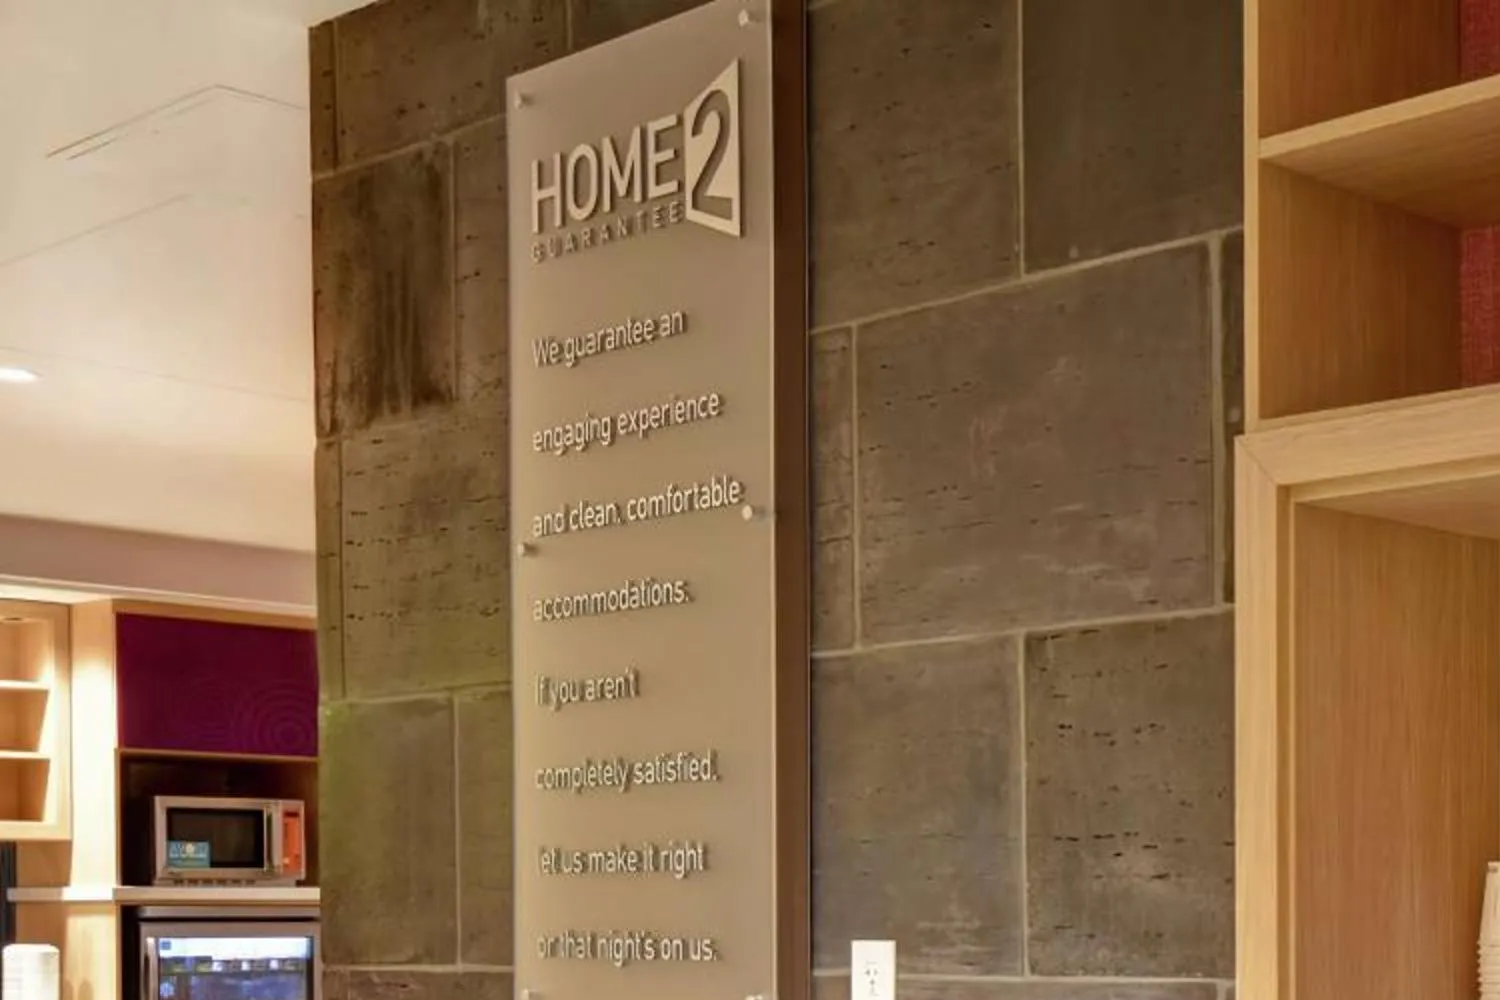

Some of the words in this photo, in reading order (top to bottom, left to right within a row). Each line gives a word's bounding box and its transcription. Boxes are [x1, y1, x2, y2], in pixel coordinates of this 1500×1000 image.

[532, 201, 684, 263] GUARANTEE
[532, 337, 559, 367] We
[564, 316, 655, 367] guarantee
[659, 311, 684, 337] an
[532, 412, 611, 456] engaging
[617, 392, 720, 439] experience
[532, 507, 565, 538] and
[627, 475, 741, 521] comfortable
[533, 578, 690, 622] accommodations.
[549, 681, 580, 711] you
[535, 757, 630, 793] completely
[633, 748, 718, 785] satisfied.
[562, 849, 583, 873] us
[589, 843, 637, 872] make
[643, 842, 655, 871] it
[660, 841, 704, 880] right
[537, 936, 557, 959] or
[561, 931, 592, 959] that
[660, 938, 683, 961] on
